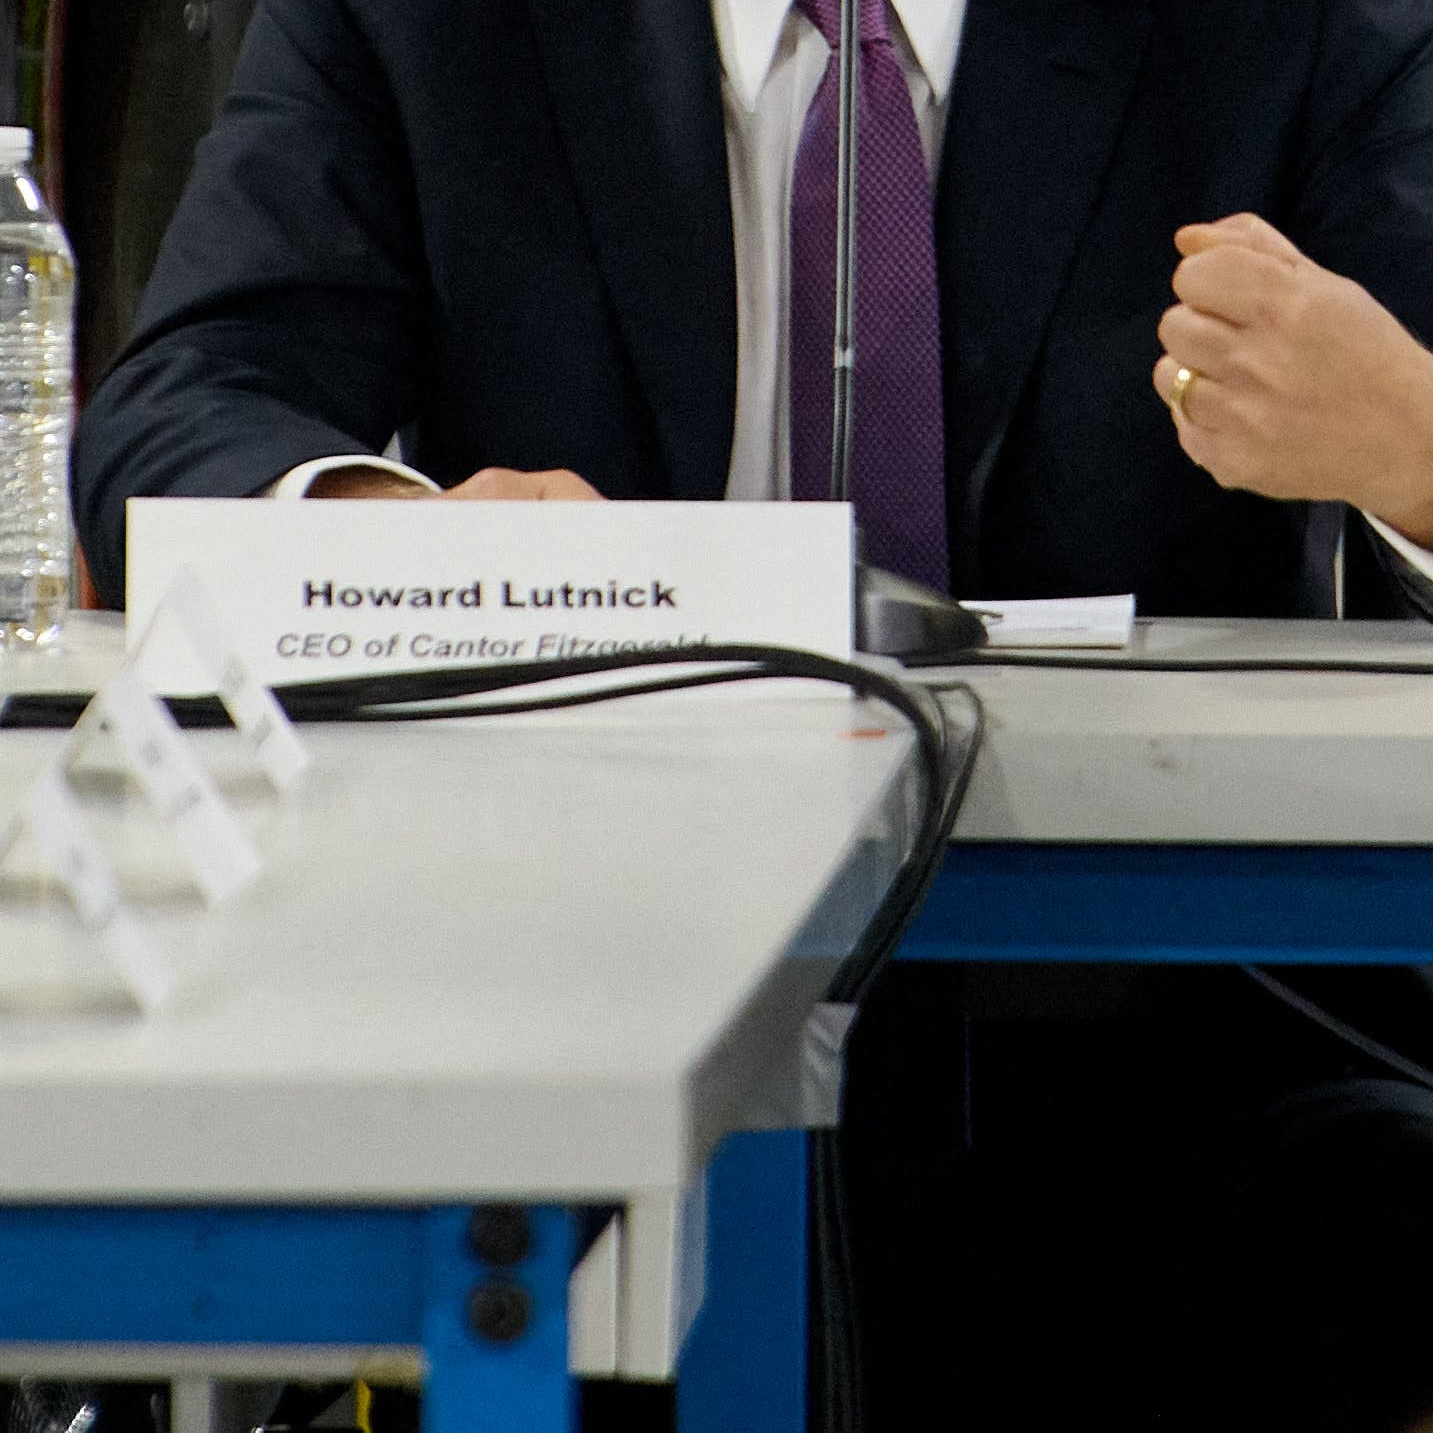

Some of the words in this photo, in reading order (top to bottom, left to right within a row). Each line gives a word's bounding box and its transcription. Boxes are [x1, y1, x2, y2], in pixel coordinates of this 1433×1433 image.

[304, 581, 482, 609] Howard
[503, 581, 677, 609] Lutnick
[276, 634, 354, 659] CEO
[365, 634, 401, 659] of
[410, 633, 526, 659] Cantor
